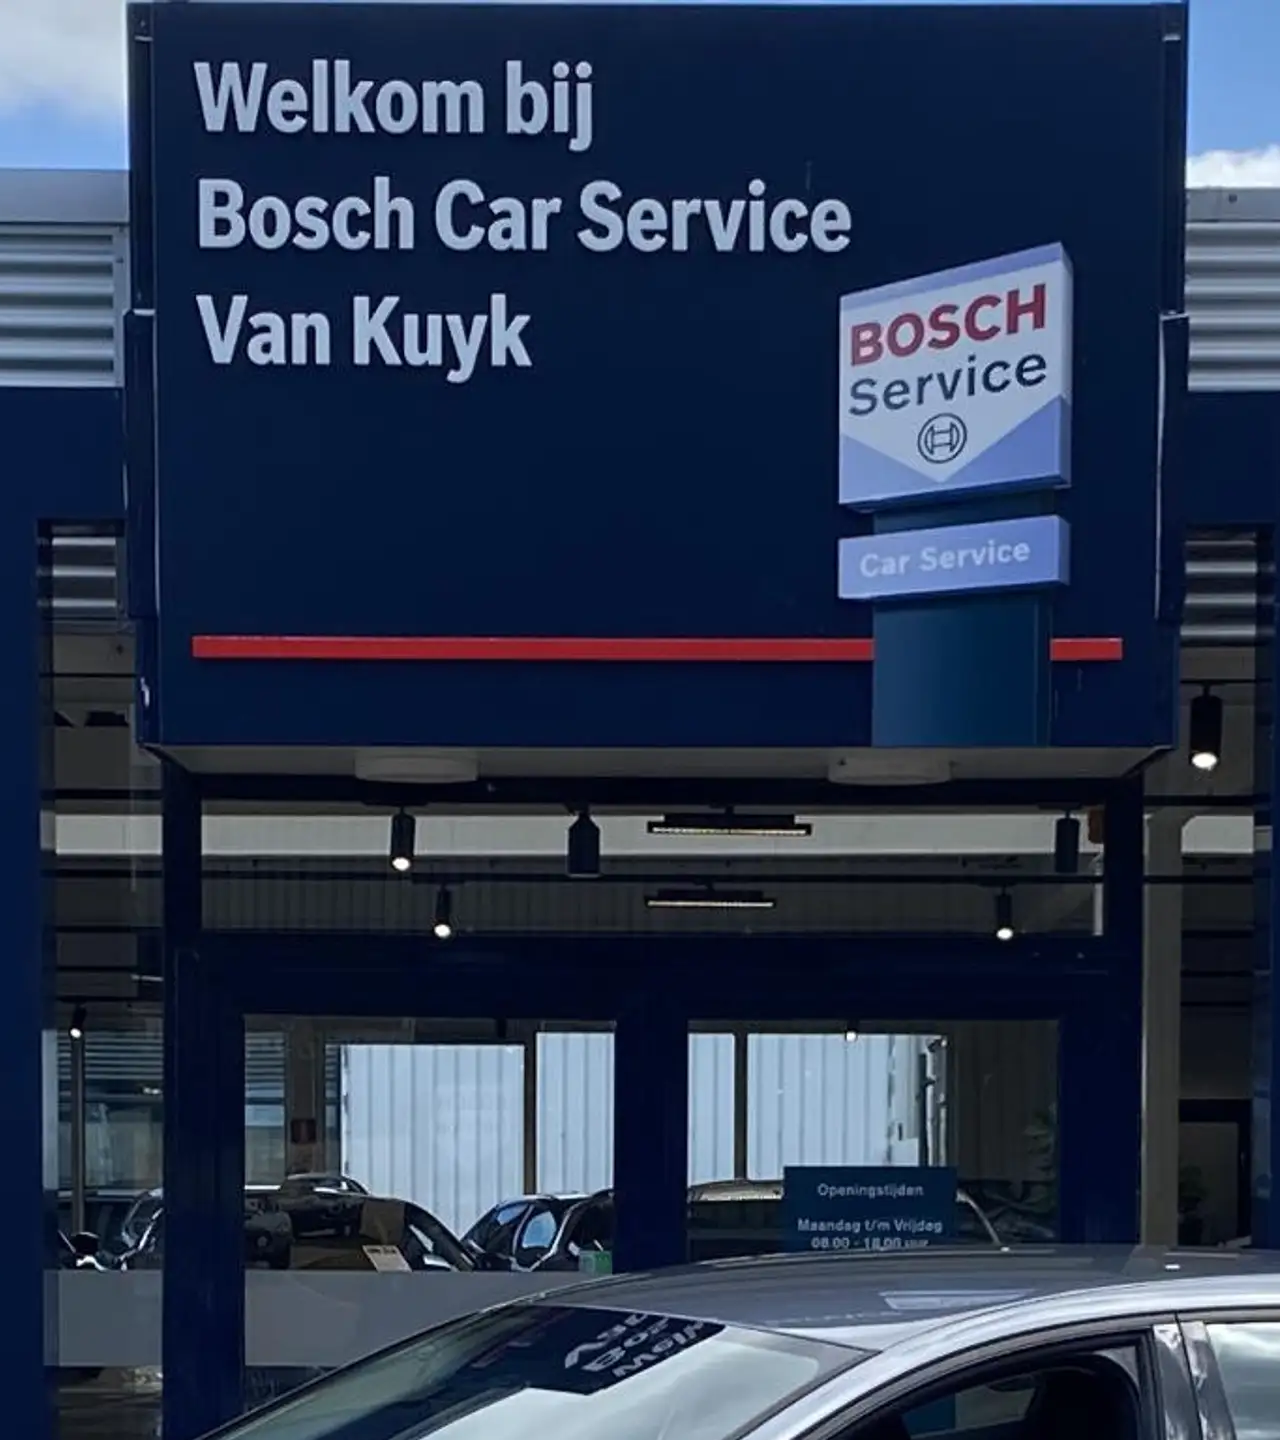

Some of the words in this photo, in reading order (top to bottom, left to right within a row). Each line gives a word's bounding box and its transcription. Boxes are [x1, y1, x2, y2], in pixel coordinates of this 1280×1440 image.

[194, 59, 486, 135] Welkom
[506, 59, 593, 152] bij
[197, 176, 415, 251] Bosch
[435, 179, 562, 252] Car
[577, 179, 852, 253] Service
[195, 294, 331, 366] Van
[353, 293, 533, 384] Kuyk
[850, 283, 1046, 366] BOSCH
[849, 352, 1047, 416] Service
[859, 553, 910, 578] Car
[919, 539, 1030, 572] Service
[796, 1217, 861, 1233] Maandag
[893, 1217, 943, 1234] Vrijdag
[816, 1182, 924, 1199] Openingstijden
